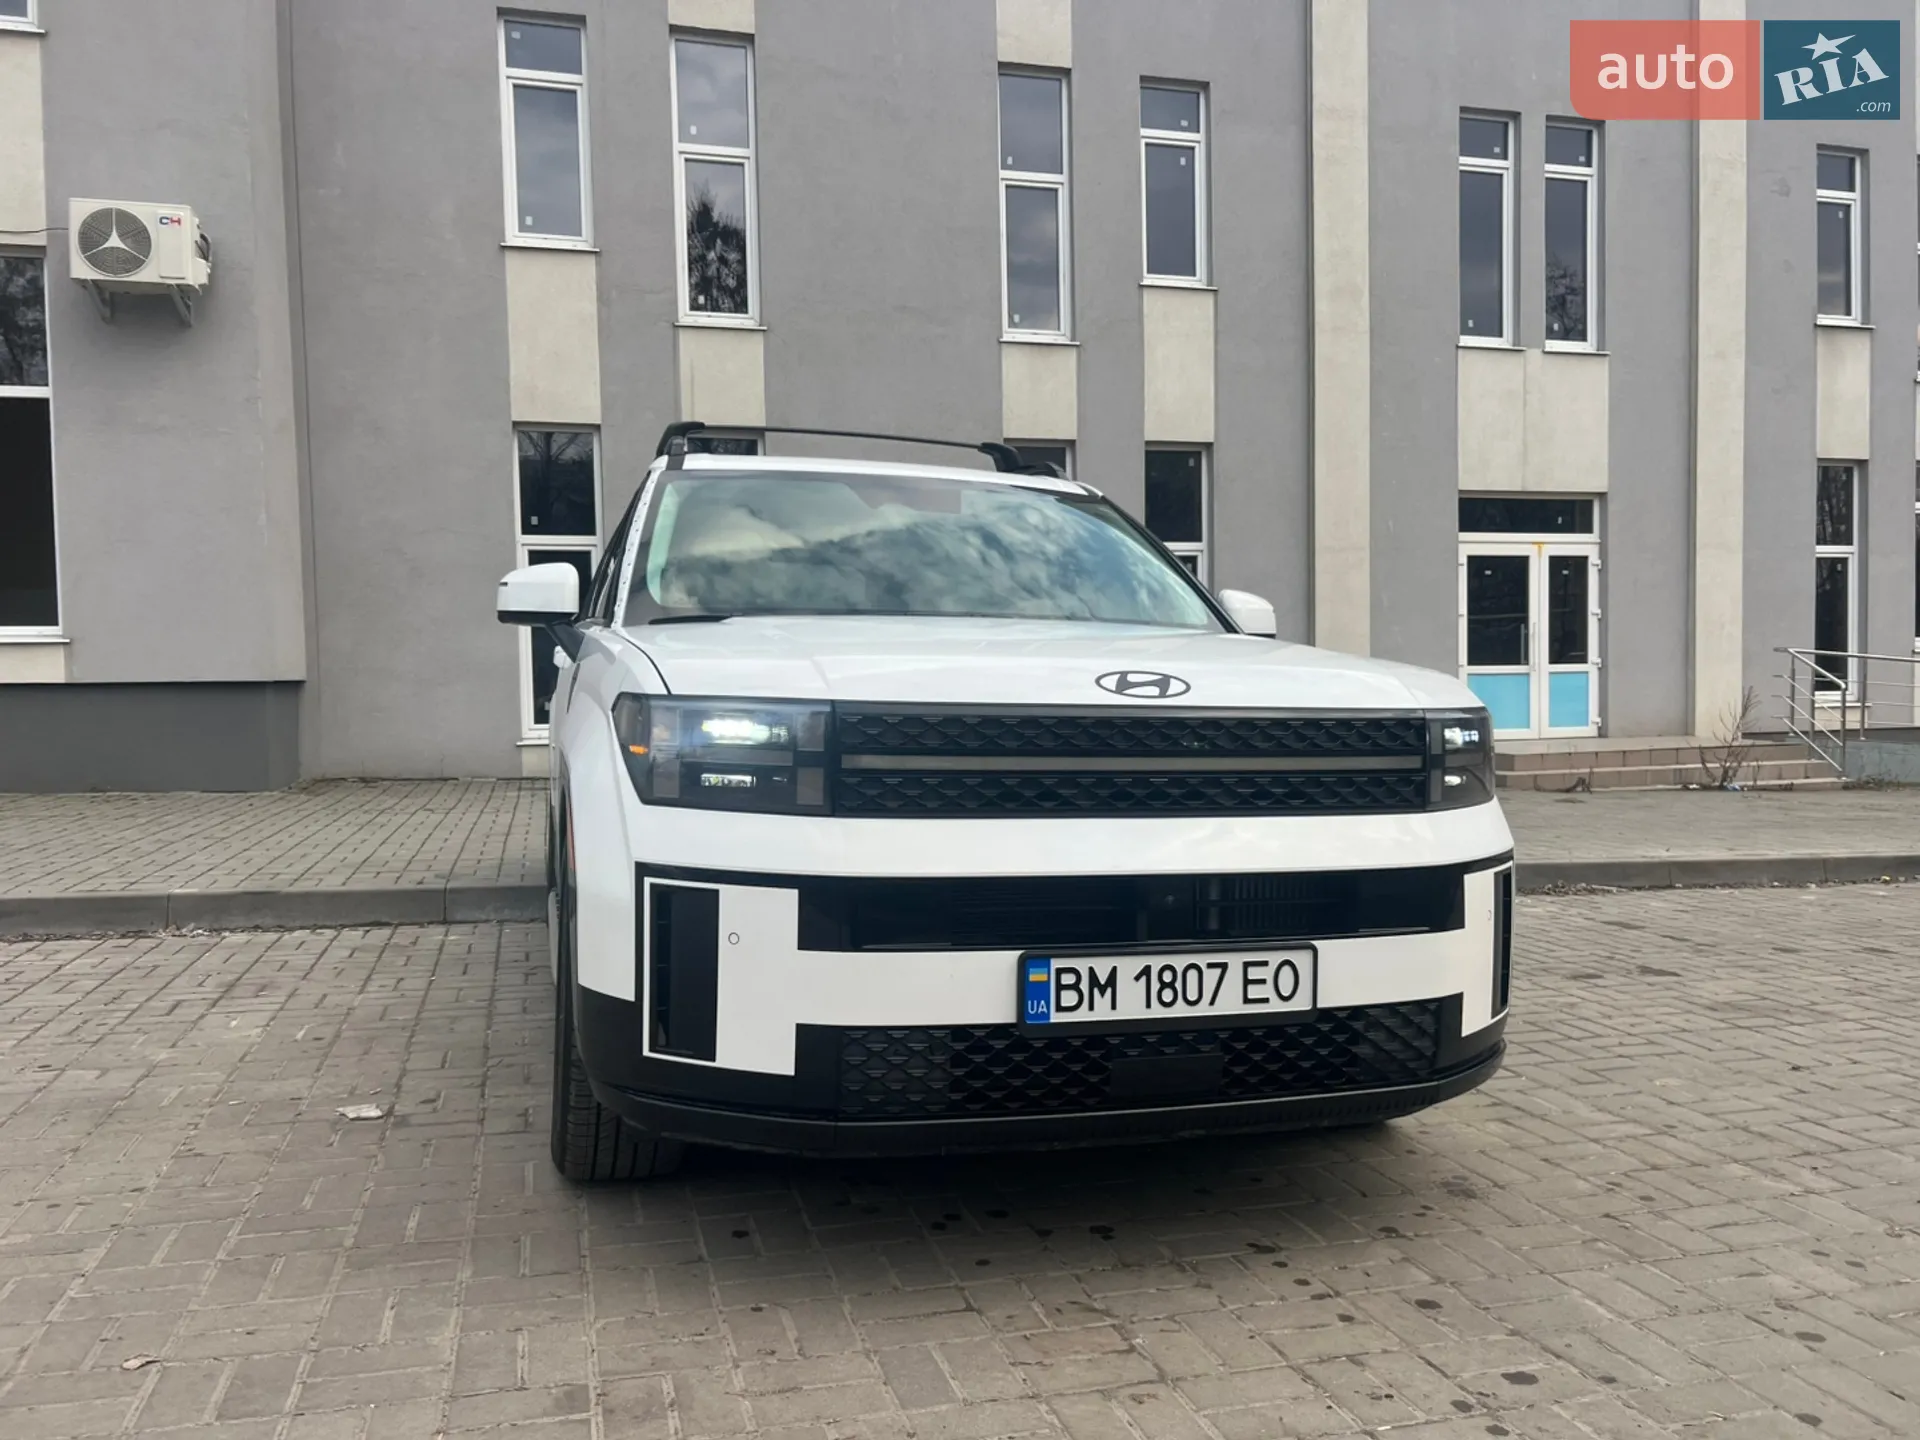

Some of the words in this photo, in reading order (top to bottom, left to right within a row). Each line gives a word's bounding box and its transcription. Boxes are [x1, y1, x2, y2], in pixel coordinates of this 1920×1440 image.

[1055, 965, 1117, 1013] BM
[1133, 961, 1229, 1009] 1807
[1243, 958, 1300, 1004] EO
[1028, 1000, 1048, 1014] UA
